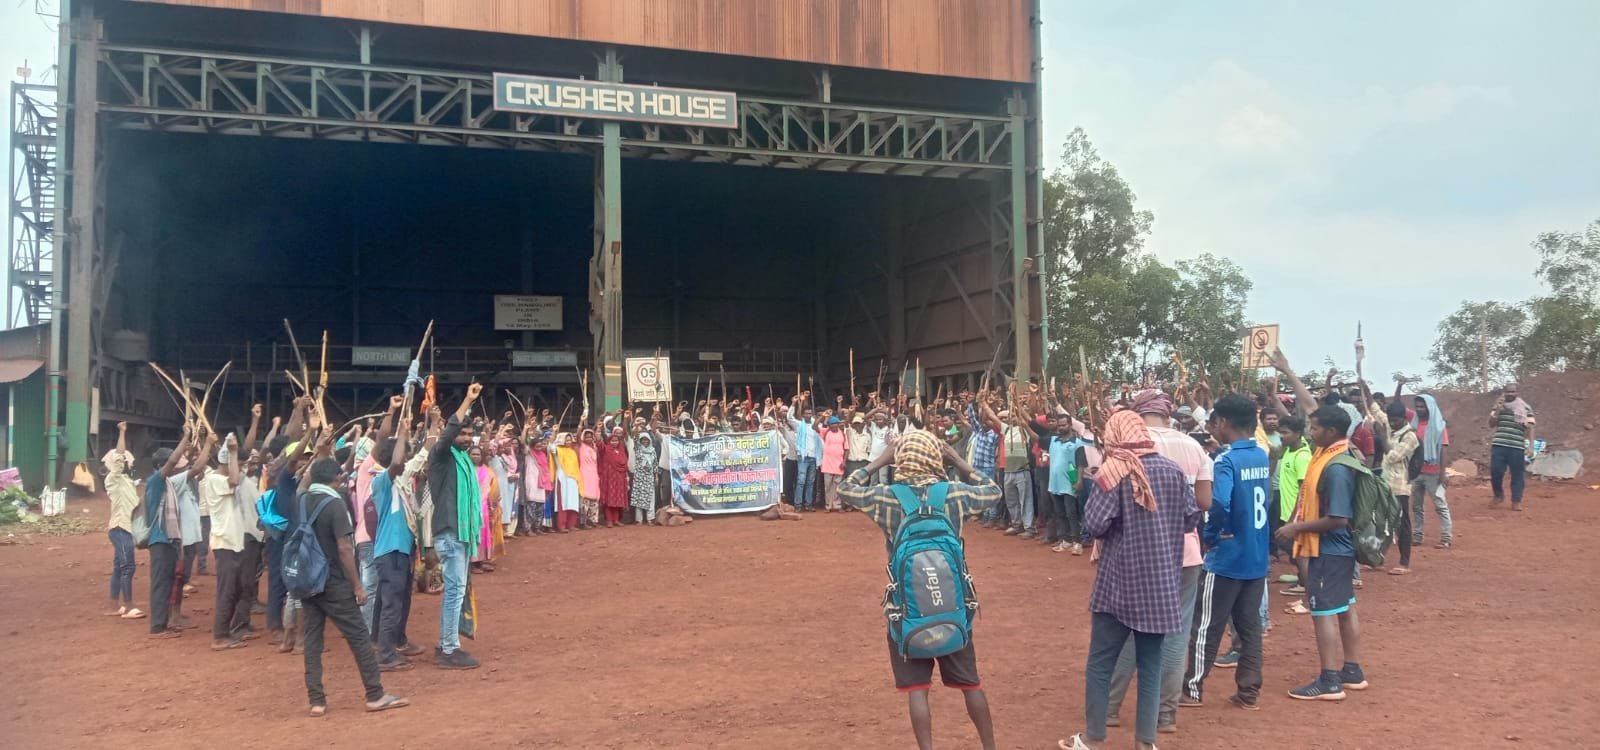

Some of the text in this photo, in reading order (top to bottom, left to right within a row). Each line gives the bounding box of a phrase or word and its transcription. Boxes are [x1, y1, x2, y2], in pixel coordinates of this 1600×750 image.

[505, 81, 727, 120] CRUSHER HOUSE
[355, 350, 408, 362] NORTH LINE
[640, 367, 656, 378] 05
[922, 566, 944, 607] safari
